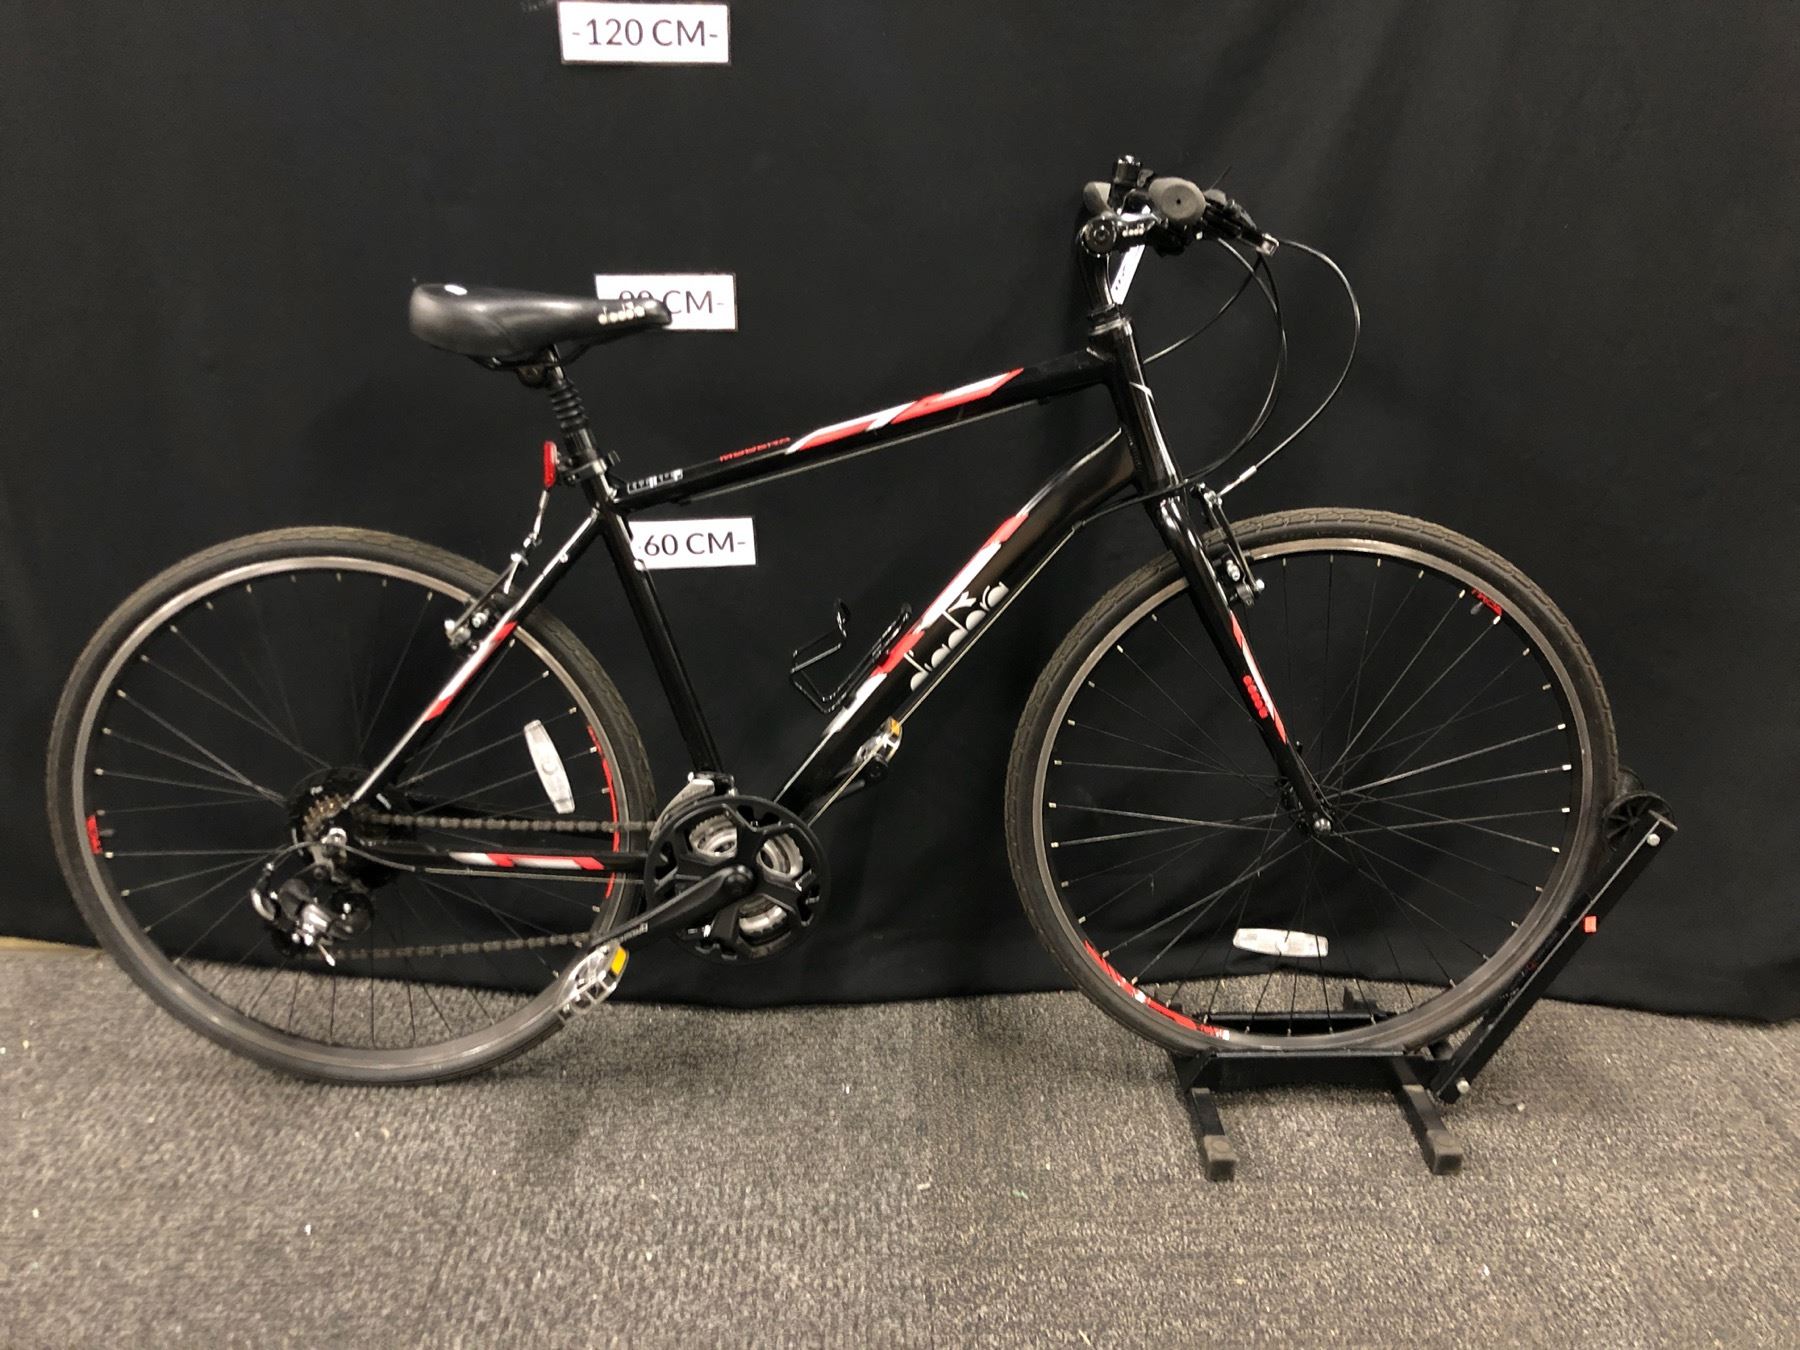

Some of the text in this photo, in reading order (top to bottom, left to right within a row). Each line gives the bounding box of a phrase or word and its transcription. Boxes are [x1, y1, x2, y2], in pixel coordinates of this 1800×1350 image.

[572, 18, 718, 46] -120 CM-
[638, 531, 746, 556] 60 CM-
